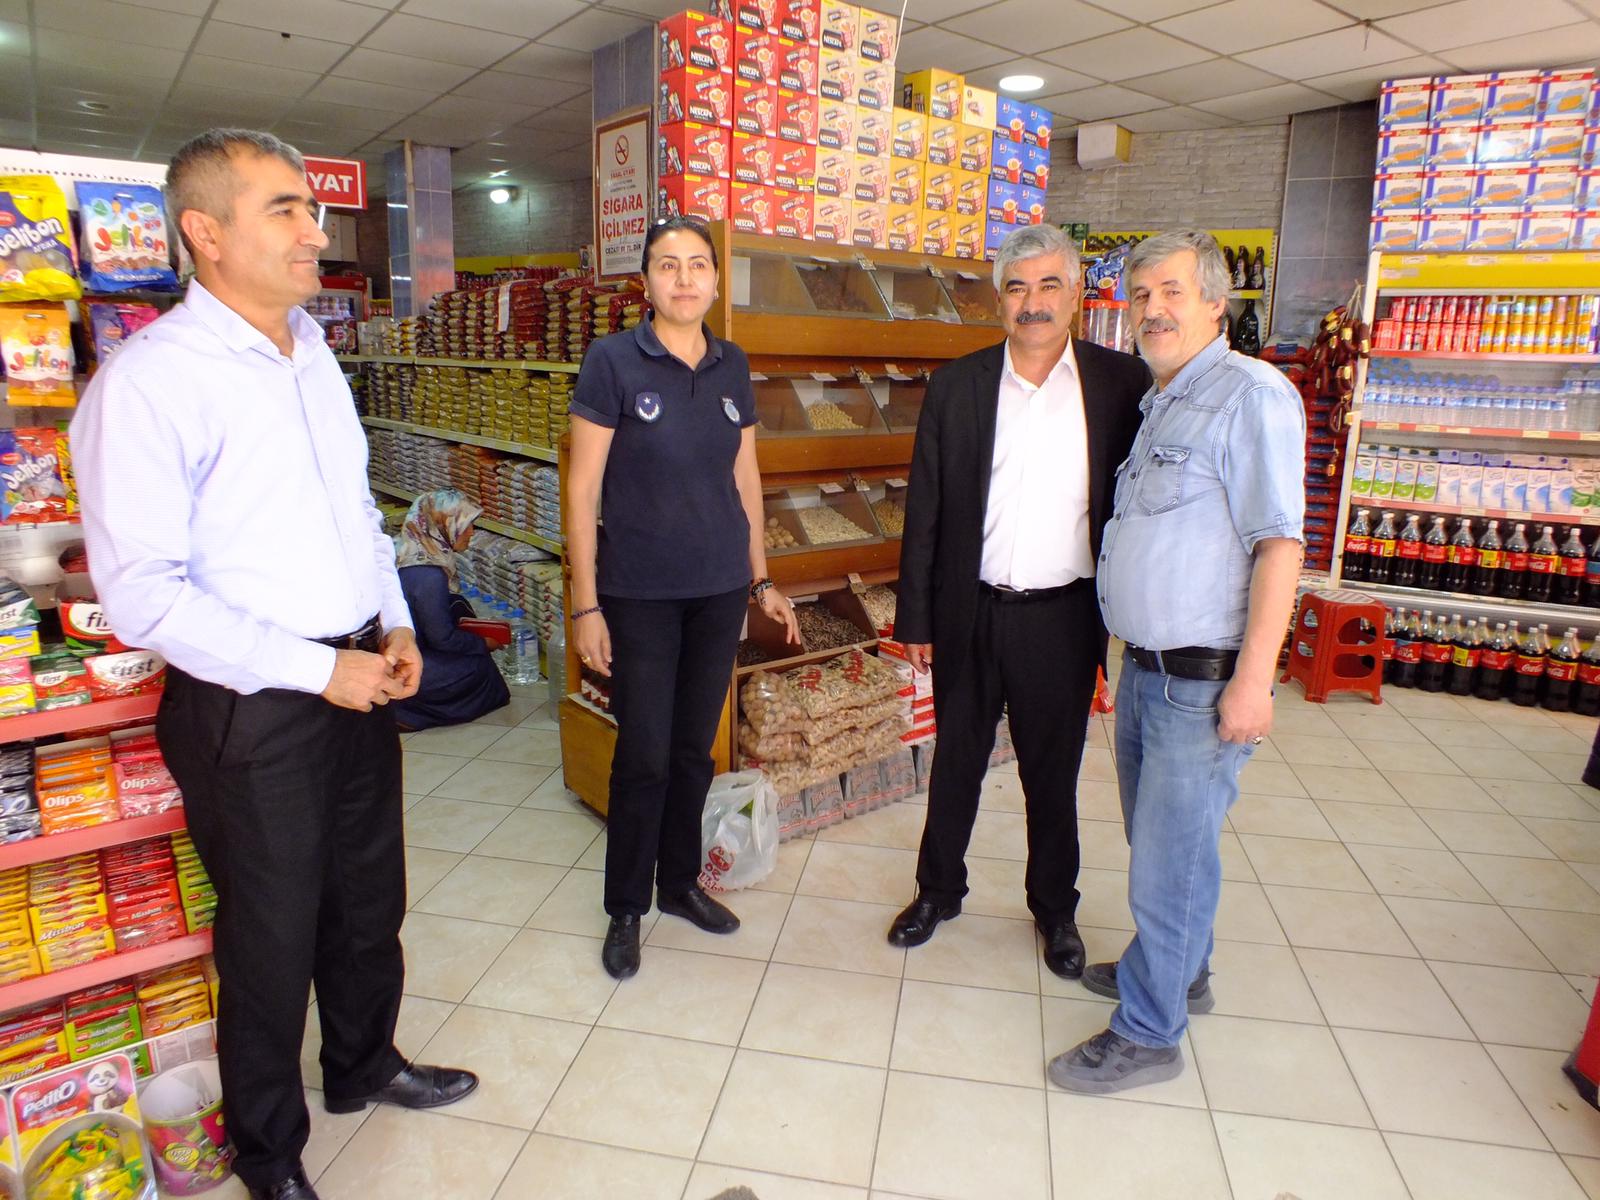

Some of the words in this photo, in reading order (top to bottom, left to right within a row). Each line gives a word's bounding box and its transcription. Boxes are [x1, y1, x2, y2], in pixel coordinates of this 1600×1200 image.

[305, 172, 353, 192] YAT
[120, 776, 159, 790] Olips
[44, 793, 84, 808] Olips
